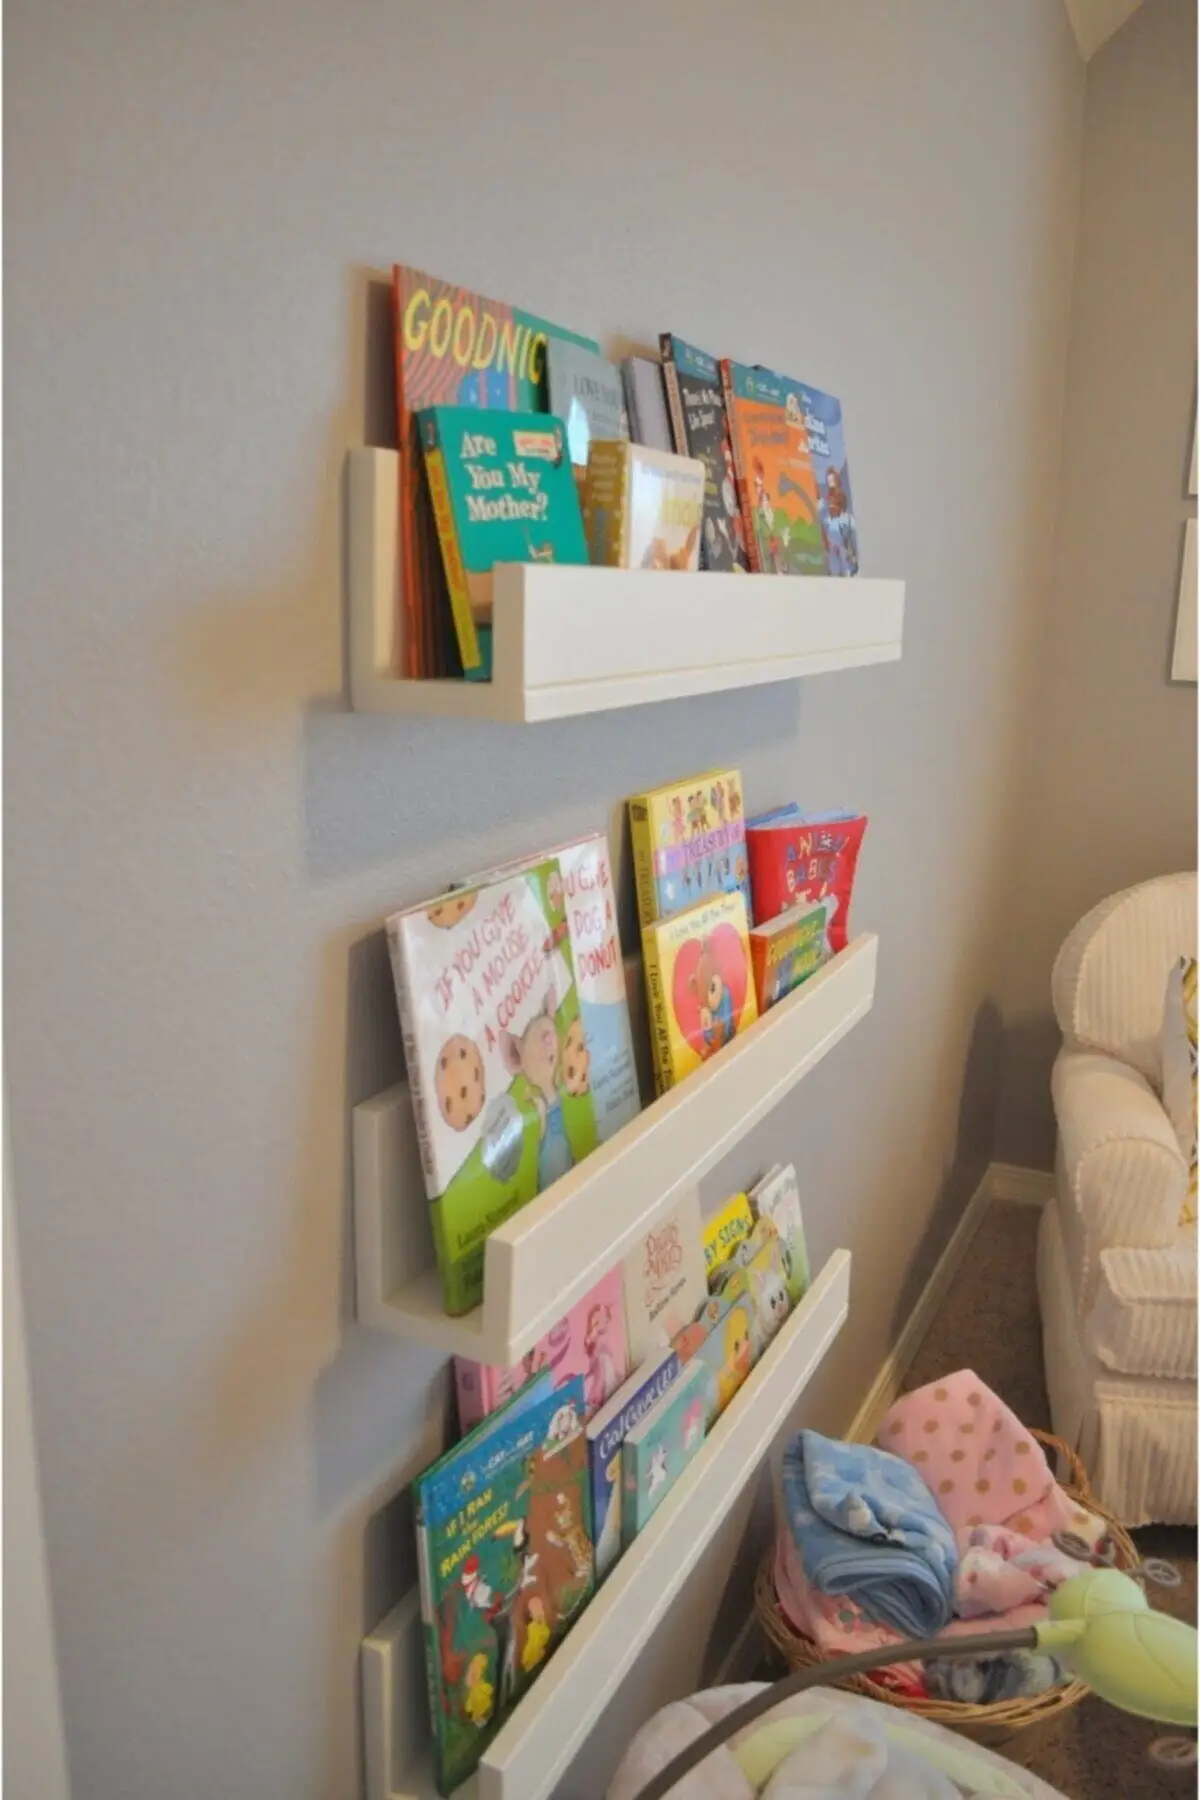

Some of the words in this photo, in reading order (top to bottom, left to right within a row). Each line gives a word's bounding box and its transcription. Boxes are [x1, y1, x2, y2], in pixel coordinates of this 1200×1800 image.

[459, 431, 497, 459] Are
[464, 463, 505, 490] You
[506, 460, 541, 496] My
[465, 492, 548, 522] Mother?
[452, 929, 481, 984] YOU
[481, 893, 516, 947] GIVE
[472, 987, 484, 1016] A
[482, 924, 529, 997] MOUSE
[484, 1024, 497, 1053] A
[497, 948, 545, 1029] COOKIE
